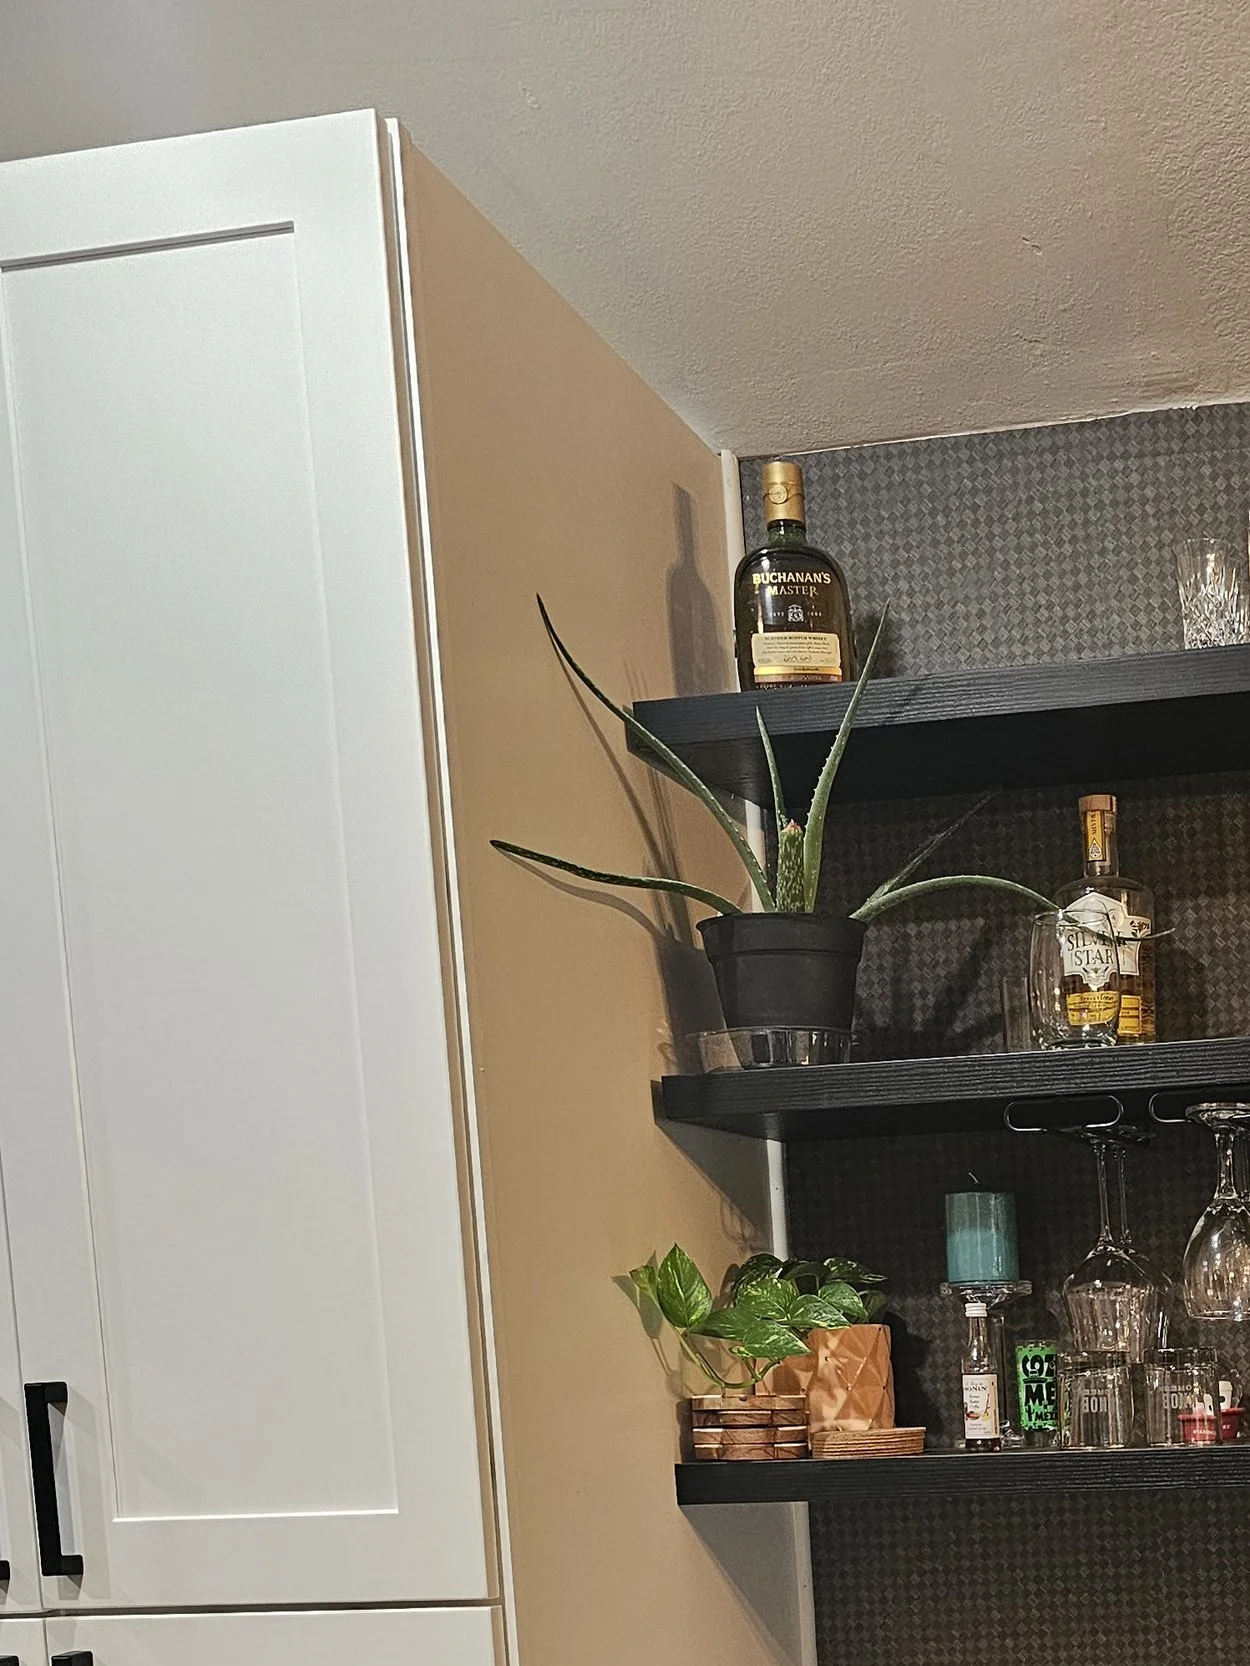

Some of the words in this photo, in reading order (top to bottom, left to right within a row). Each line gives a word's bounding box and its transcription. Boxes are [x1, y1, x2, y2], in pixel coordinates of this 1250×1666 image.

[752, 572, 831, 584] BUCHANAN'S
[767, 585, 818, 598] MASTER
[1074, 948, 1115, 966] STAR
